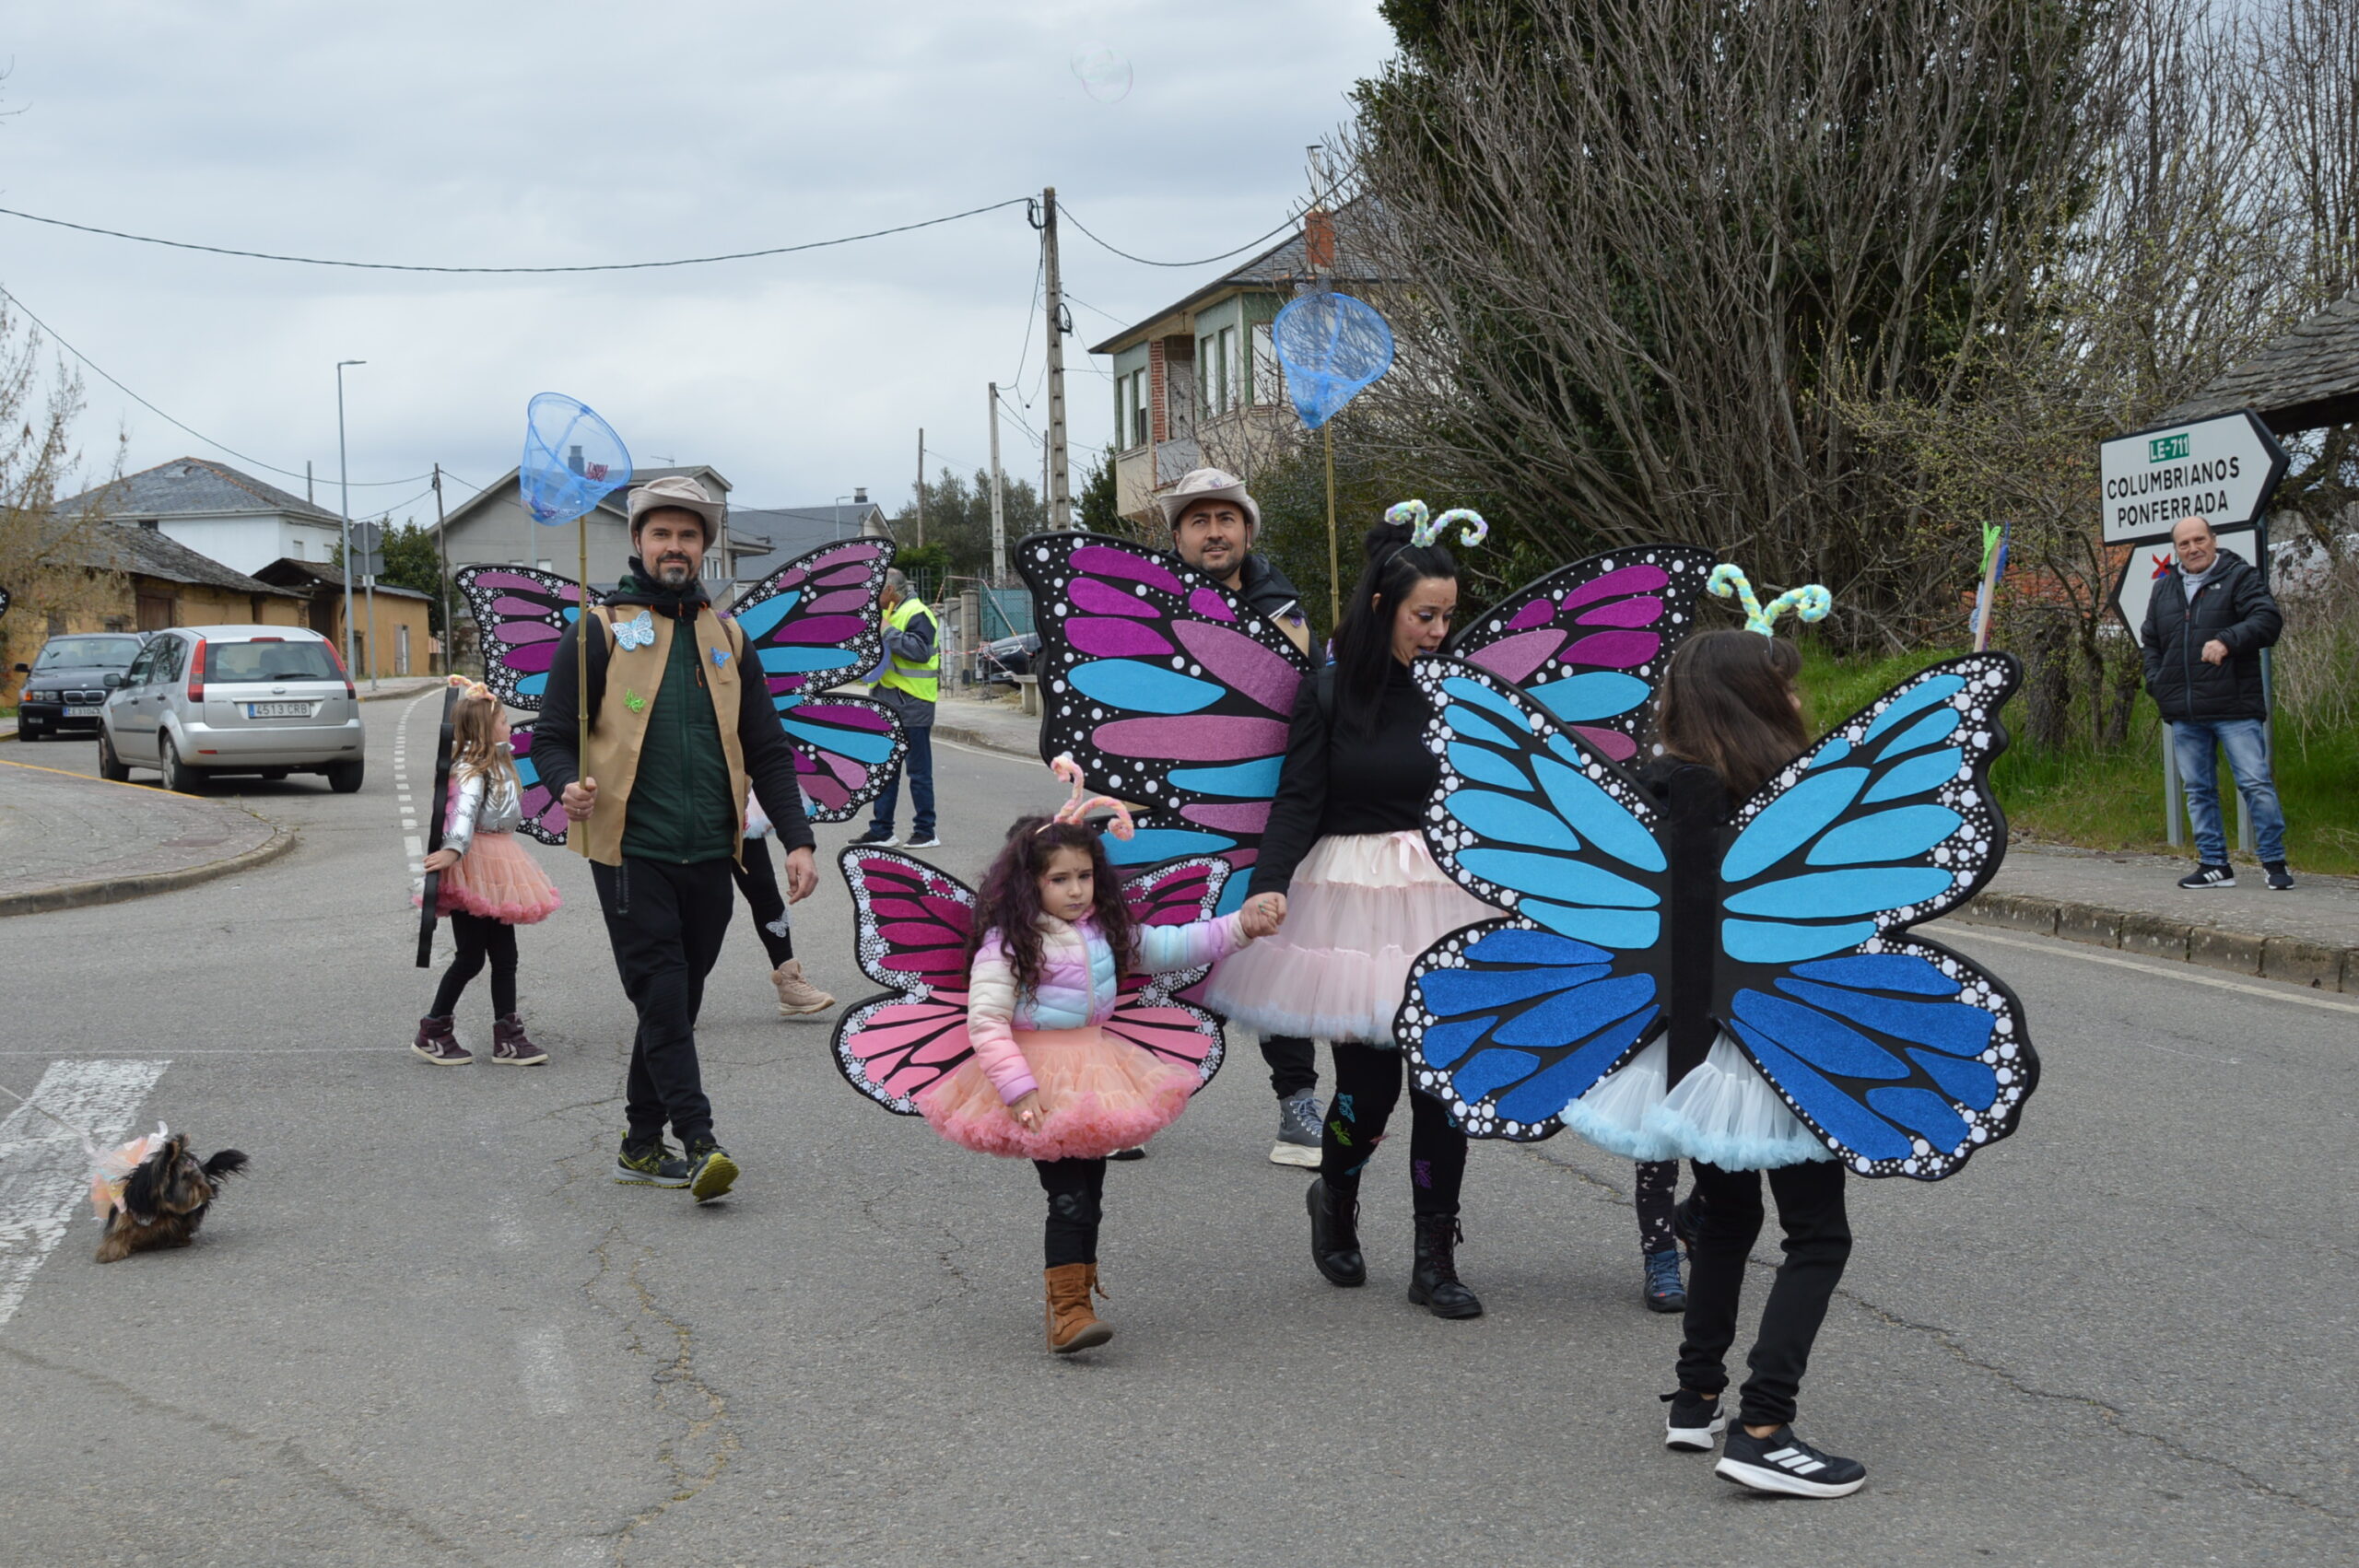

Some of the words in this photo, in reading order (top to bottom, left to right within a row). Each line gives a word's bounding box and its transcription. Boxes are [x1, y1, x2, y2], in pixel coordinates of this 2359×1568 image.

[2150, 437, 2189, 461] LE-711
[2107, 456, 2240, 500] COLUMBRIANOS
[2118, 490, 2229, 528] PONFERRADA
[256, 704, 285, 715] 4513
[287, 704, 308, 714] CRB
